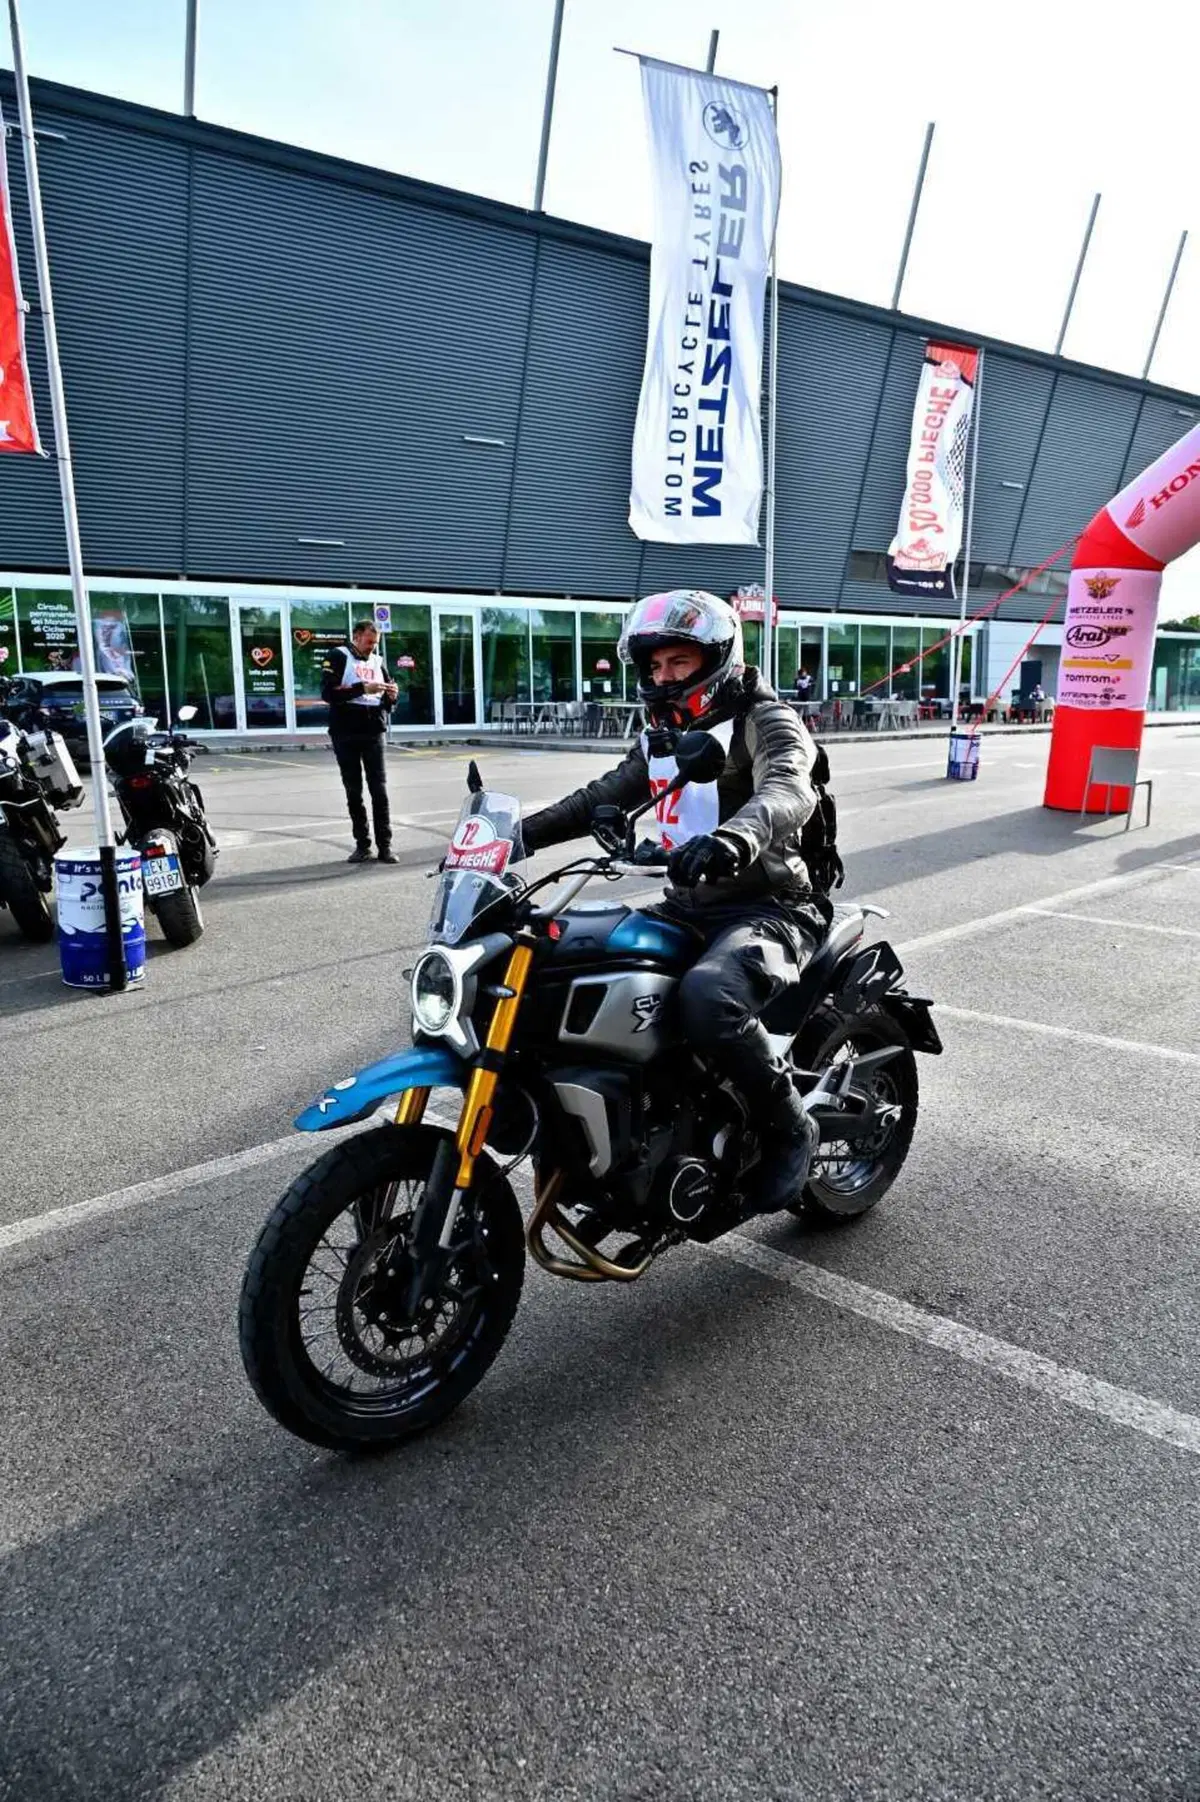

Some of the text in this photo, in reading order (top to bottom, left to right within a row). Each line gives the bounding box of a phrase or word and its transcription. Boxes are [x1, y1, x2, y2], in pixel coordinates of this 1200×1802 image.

[1069, 606, 1123, 614] METZELER
[1068, 627, 1104, 642] Arai
[461, 822, 480, 846] 12
[460, 846, 501, 869] PIEGHE
[150, 859, 163, 874] EV
[147, 872, 179, 891] 99187
